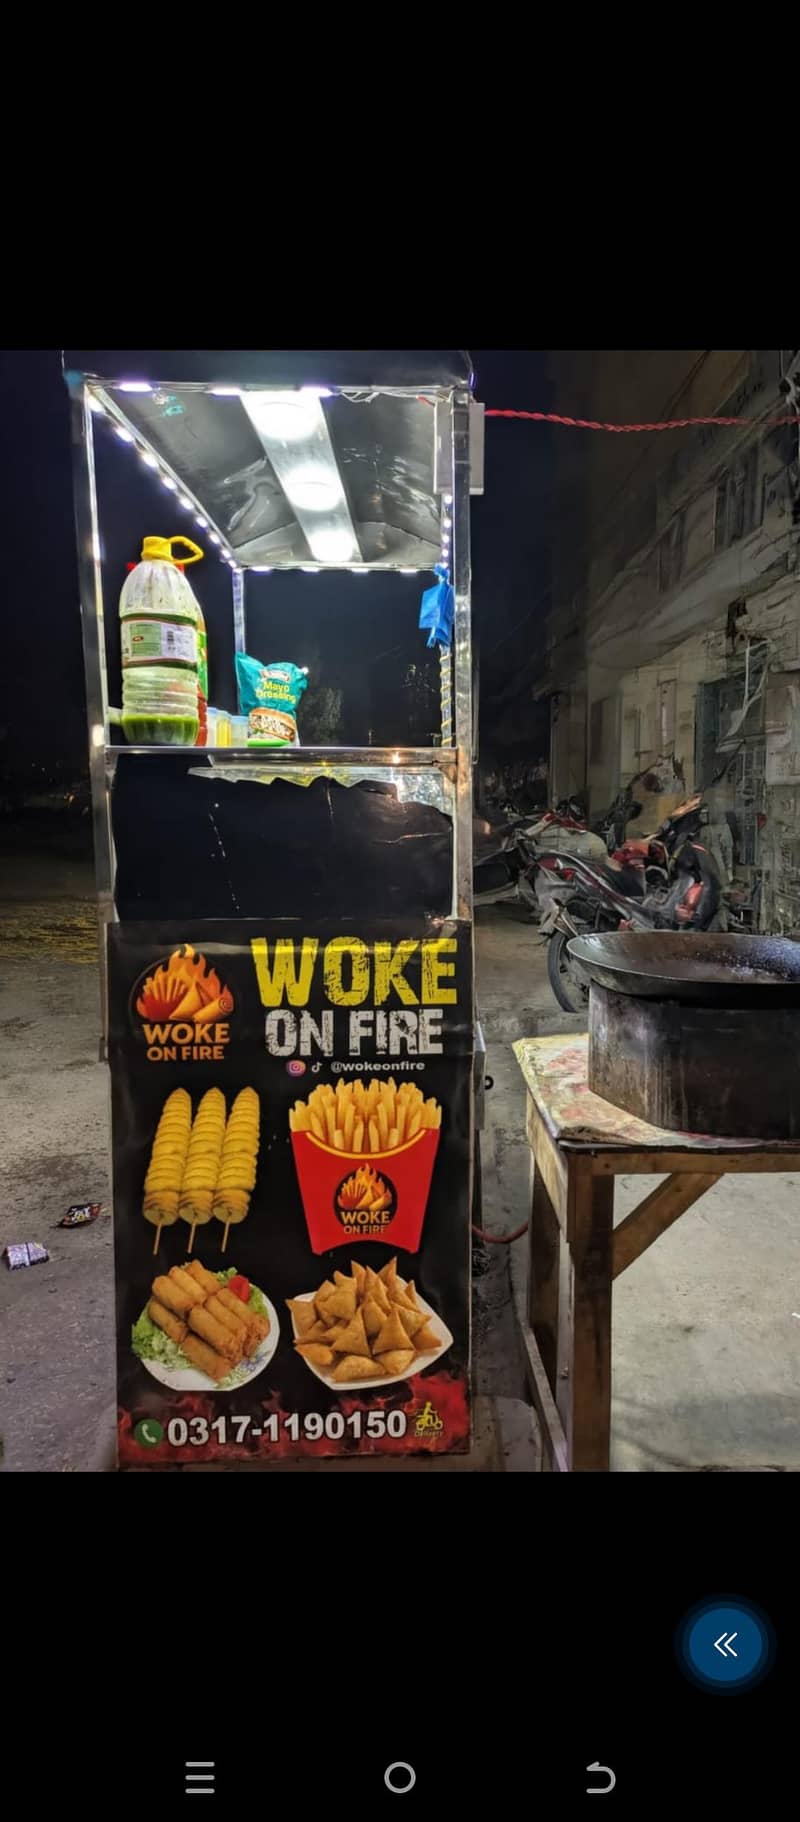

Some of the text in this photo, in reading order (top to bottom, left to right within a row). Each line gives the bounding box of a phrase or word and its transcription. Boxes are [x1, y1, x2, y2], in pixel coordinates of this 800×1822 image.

[263, 680, 290, 693] Mayo
[251, 936, 458, 1007] WOKE
[142, 1023, 230, 1045] WOKE
[265, 1009, 444, 1057] ON FIRE
[146, 1045, 225, 1062] ON FIRE
[330, 1061, 425, 1073] @wokeonfire
[341, 1210, 390, 1225] WOKE
[343, 1225, 361, 1235] ON
[167, 1410, 407, 1446] 0317-1190150
